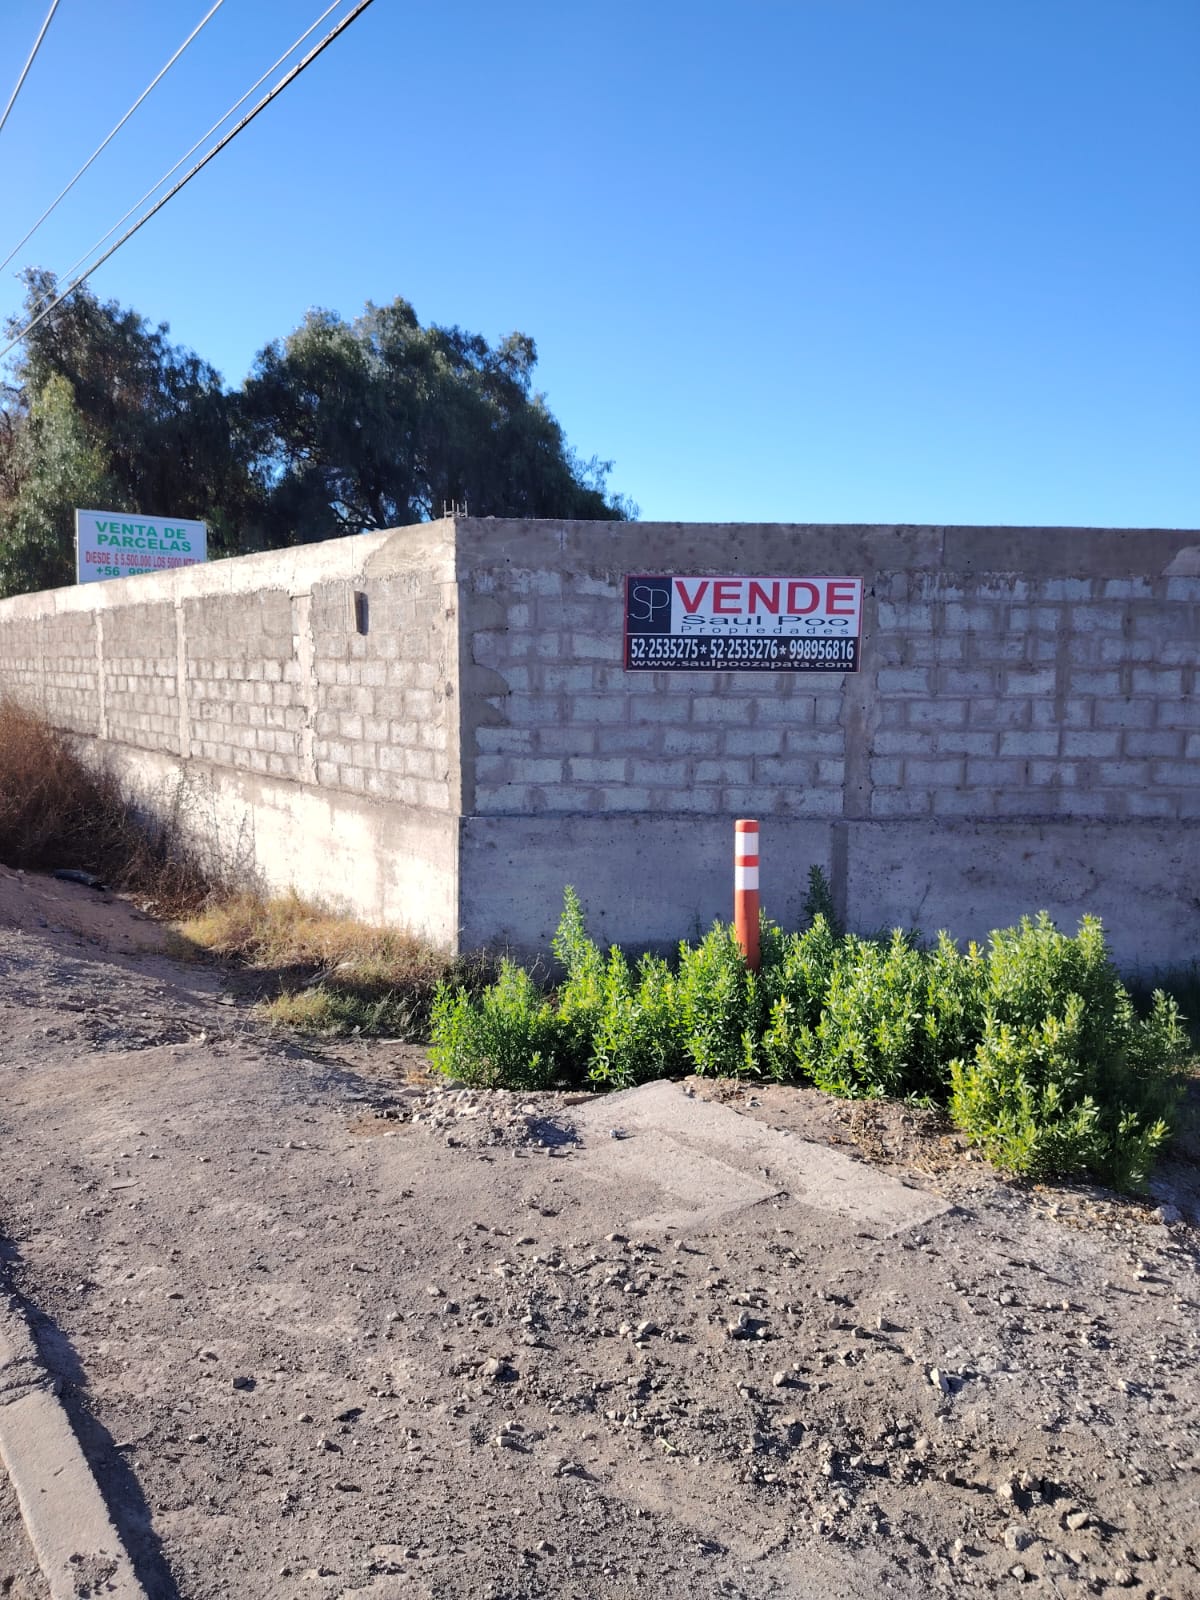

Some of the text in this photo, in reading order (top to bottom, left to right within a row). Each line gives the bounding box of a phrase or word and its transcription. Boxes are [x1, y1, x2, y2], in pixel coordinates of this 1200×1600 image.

[95, 520, 187, 540] VENTA DE
[97, 534, 192, 552] PARCELAS
[153, 556, 166, 569] LOS
[96, 566, 120, 577] +56
[674, 580, 857, 615] VENDE
[681, 615, 850, 627] Saul Poo
[680, 625, 849, 635] Propiedades
[788, 640, 855, 660] 998956816
[631, 660, 854, 670] www.saulpoozapata.com
